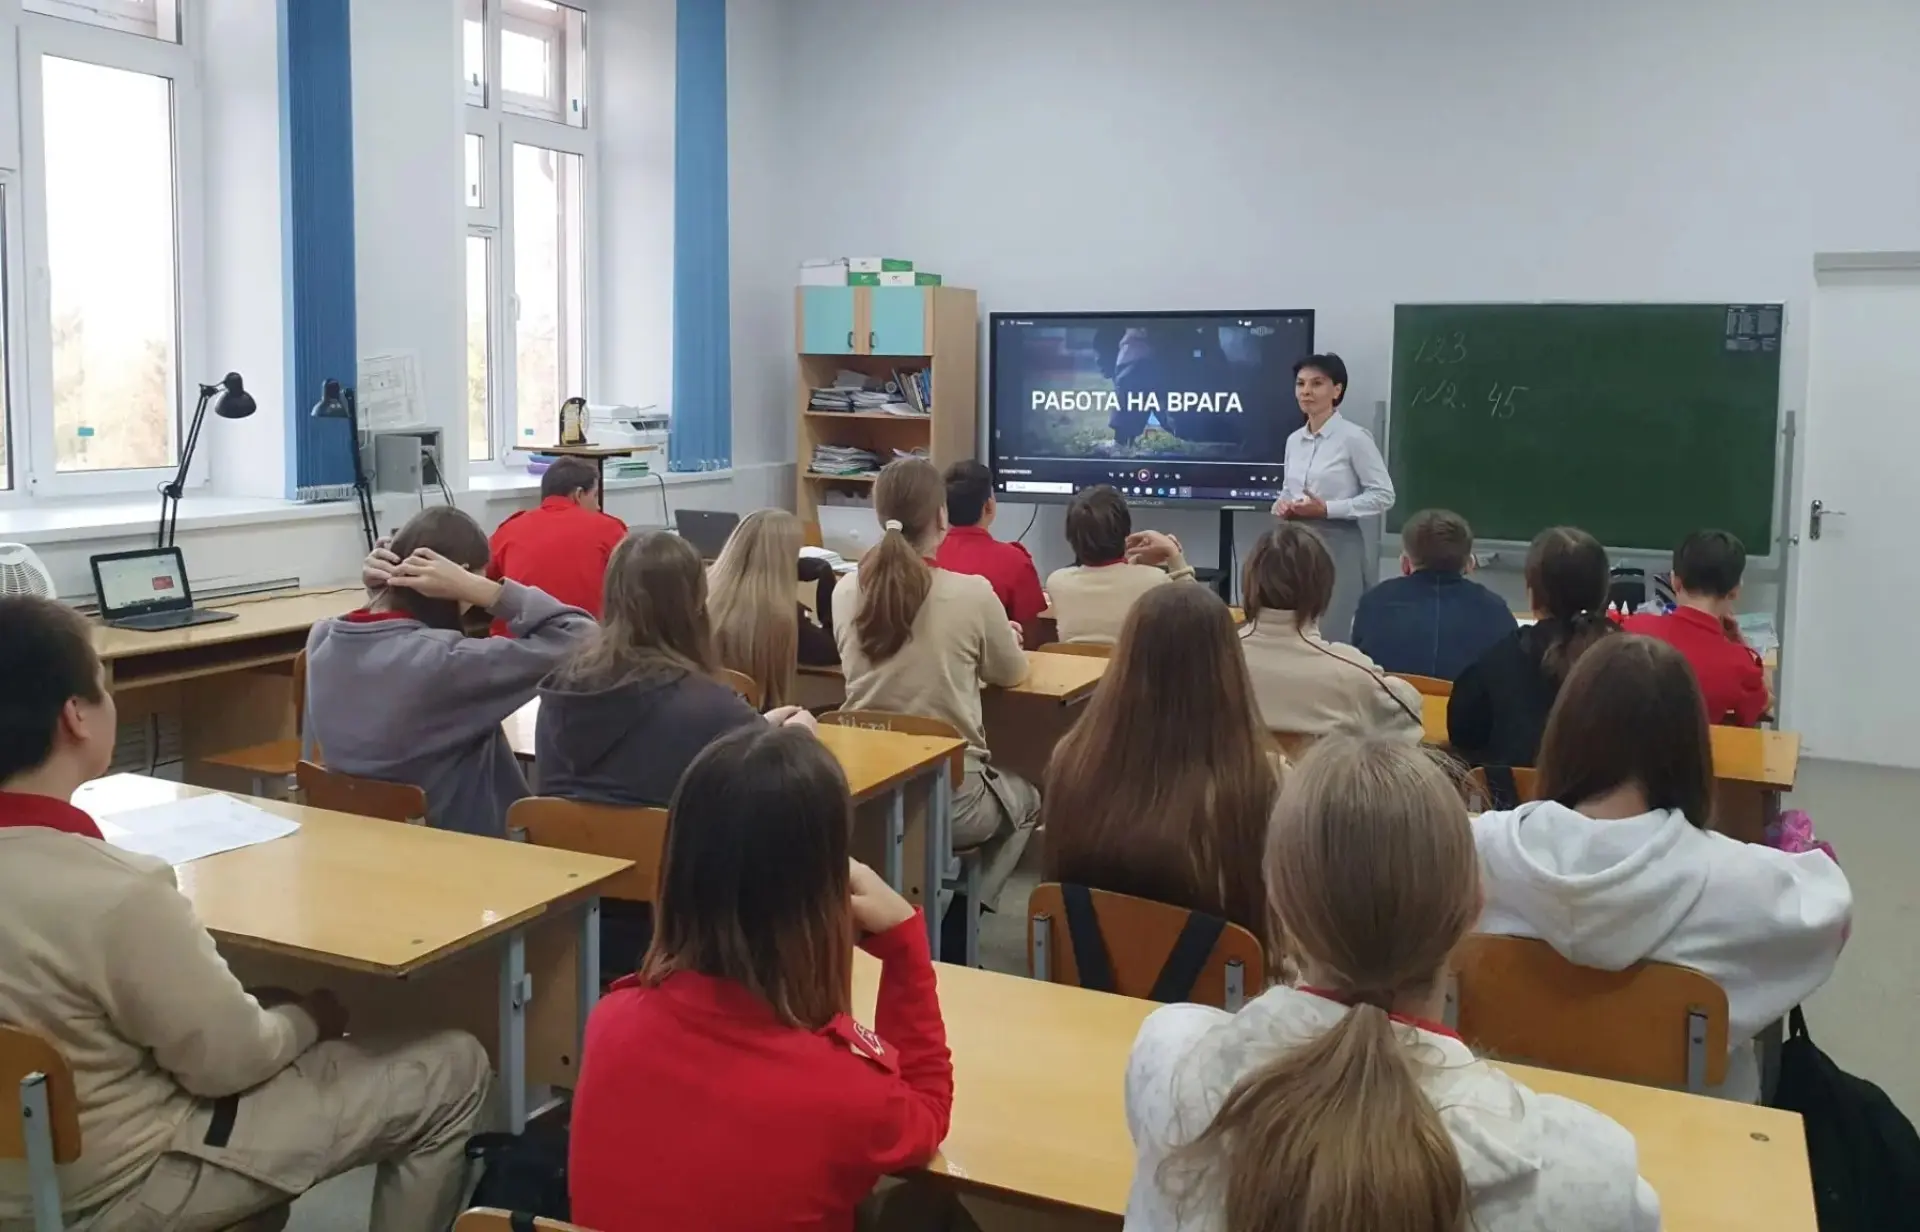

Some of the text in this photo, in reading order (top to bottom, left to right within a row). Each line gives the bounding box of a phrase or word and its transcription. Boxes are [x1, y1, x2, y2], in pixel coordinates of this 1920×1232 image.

[1031, 390, 1244, 413] РАБОТА НА ВРАГА
[1488, 381, 1531, 419] 45
